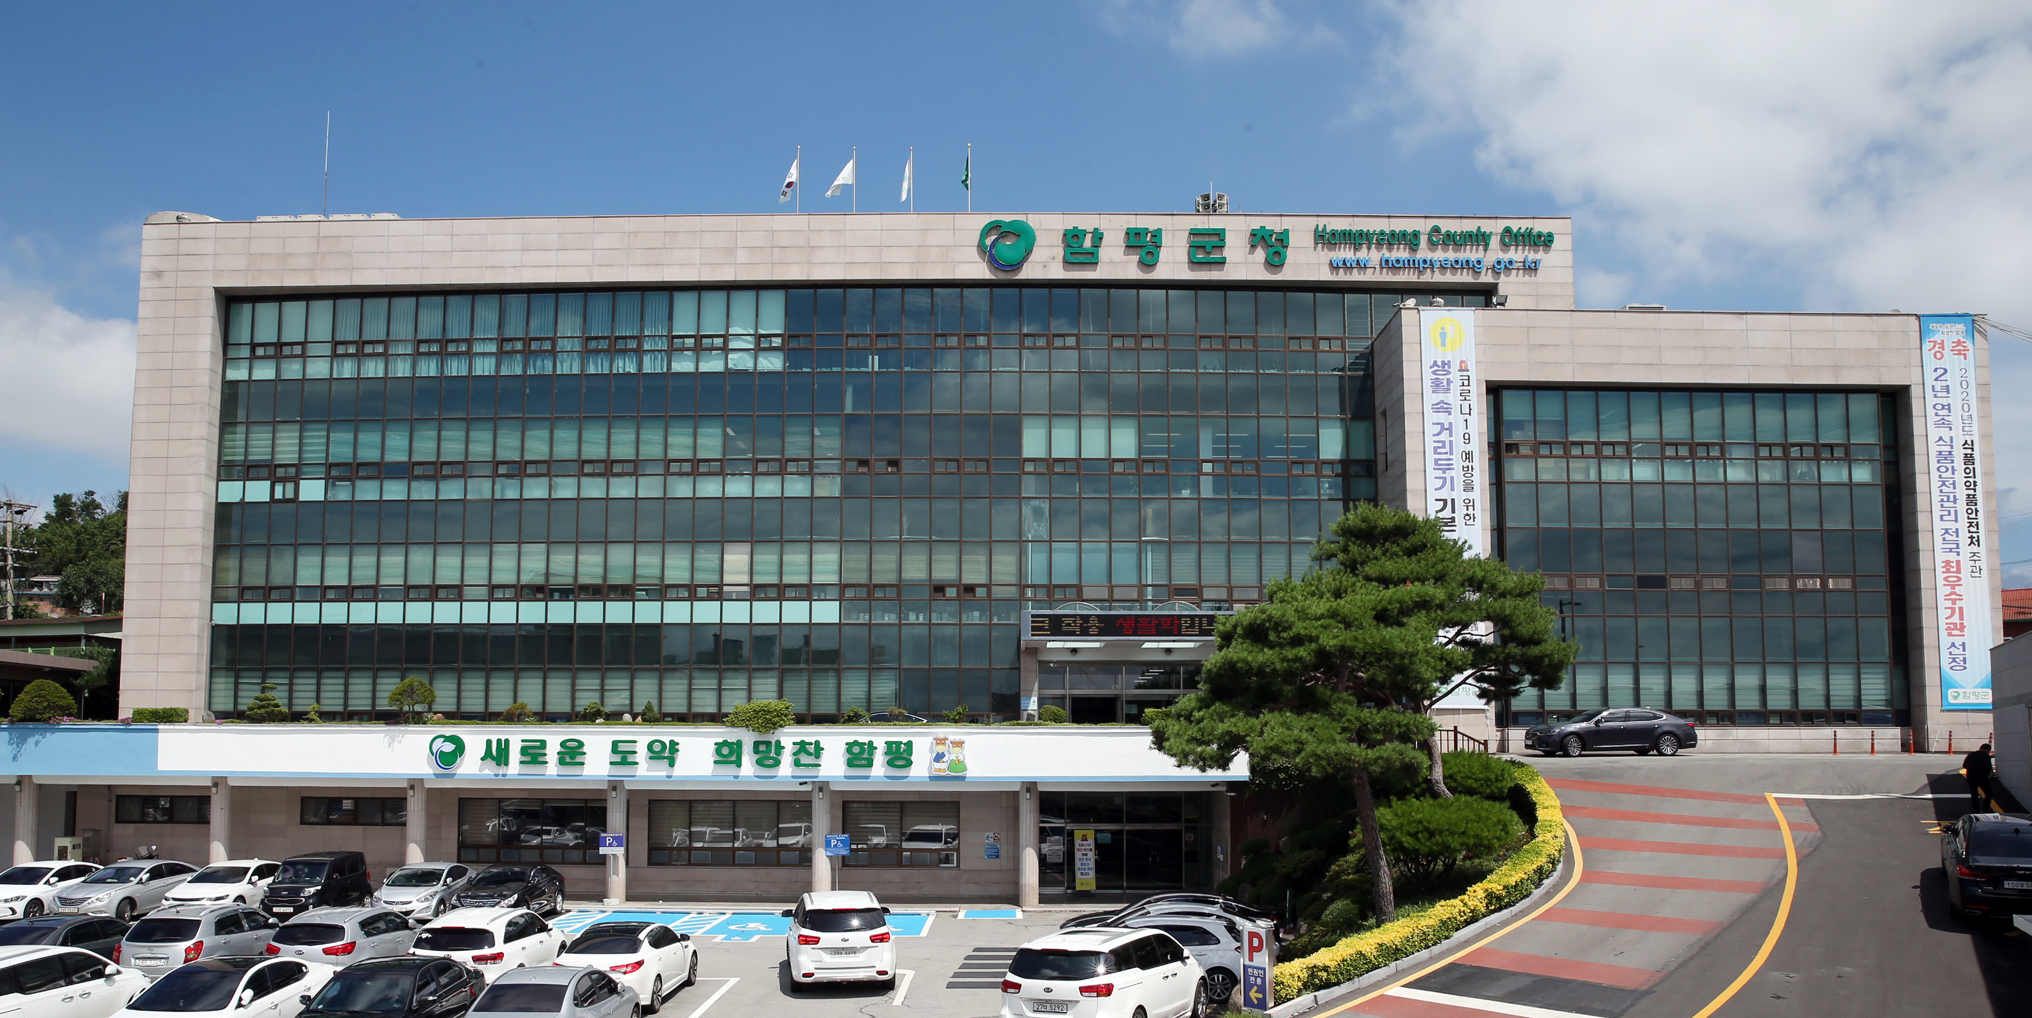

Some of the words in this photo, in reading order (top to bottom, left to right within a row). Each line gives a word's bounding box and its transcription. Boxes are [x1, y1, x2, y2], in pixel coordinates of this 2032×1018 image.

[1064, 225, 1290, 266] 함평군청
[1315, 223, 1421, 251] Hampyeong
[1428, 224, 1493, 251] County
[1501, 225, 1555, 246] Office
[1429, 360, 1454, 395] 생활
[1458, 374, 1474, 446] 코로나19
[1959, 367, 1975, 437] 2020년도
[1432, 421, 1456, 493] 거리두기
[1460, 450, 1475, 494] 예방을
[1934, 435, 1959, 524] 식품안전관리
[1961, 439, 1981, 548] 식품의약품안전처
[1462, 498, 1476, 527] 위한
[1939, 527, 1962, 557] 전국
[1968, 551, 1983, 579] 주관
[1941, 559, 1967, 638] 최우수기관
[1946, 641, 1968, 672] 선정
[1962, 691, 1989, 700] 함평군
[480, 738, 587, 767] 새로운
[609, 739, 681, 768] 도약
[713, 739, 824, 768] 희망찬
[845, 739, 914, 768] 함평
[606, 836, 613, 847] P
[831, 839, 838, 848] P
[1248, 931, 1264, 962] P
[1049, 1004, 1065, 1012] 5292
